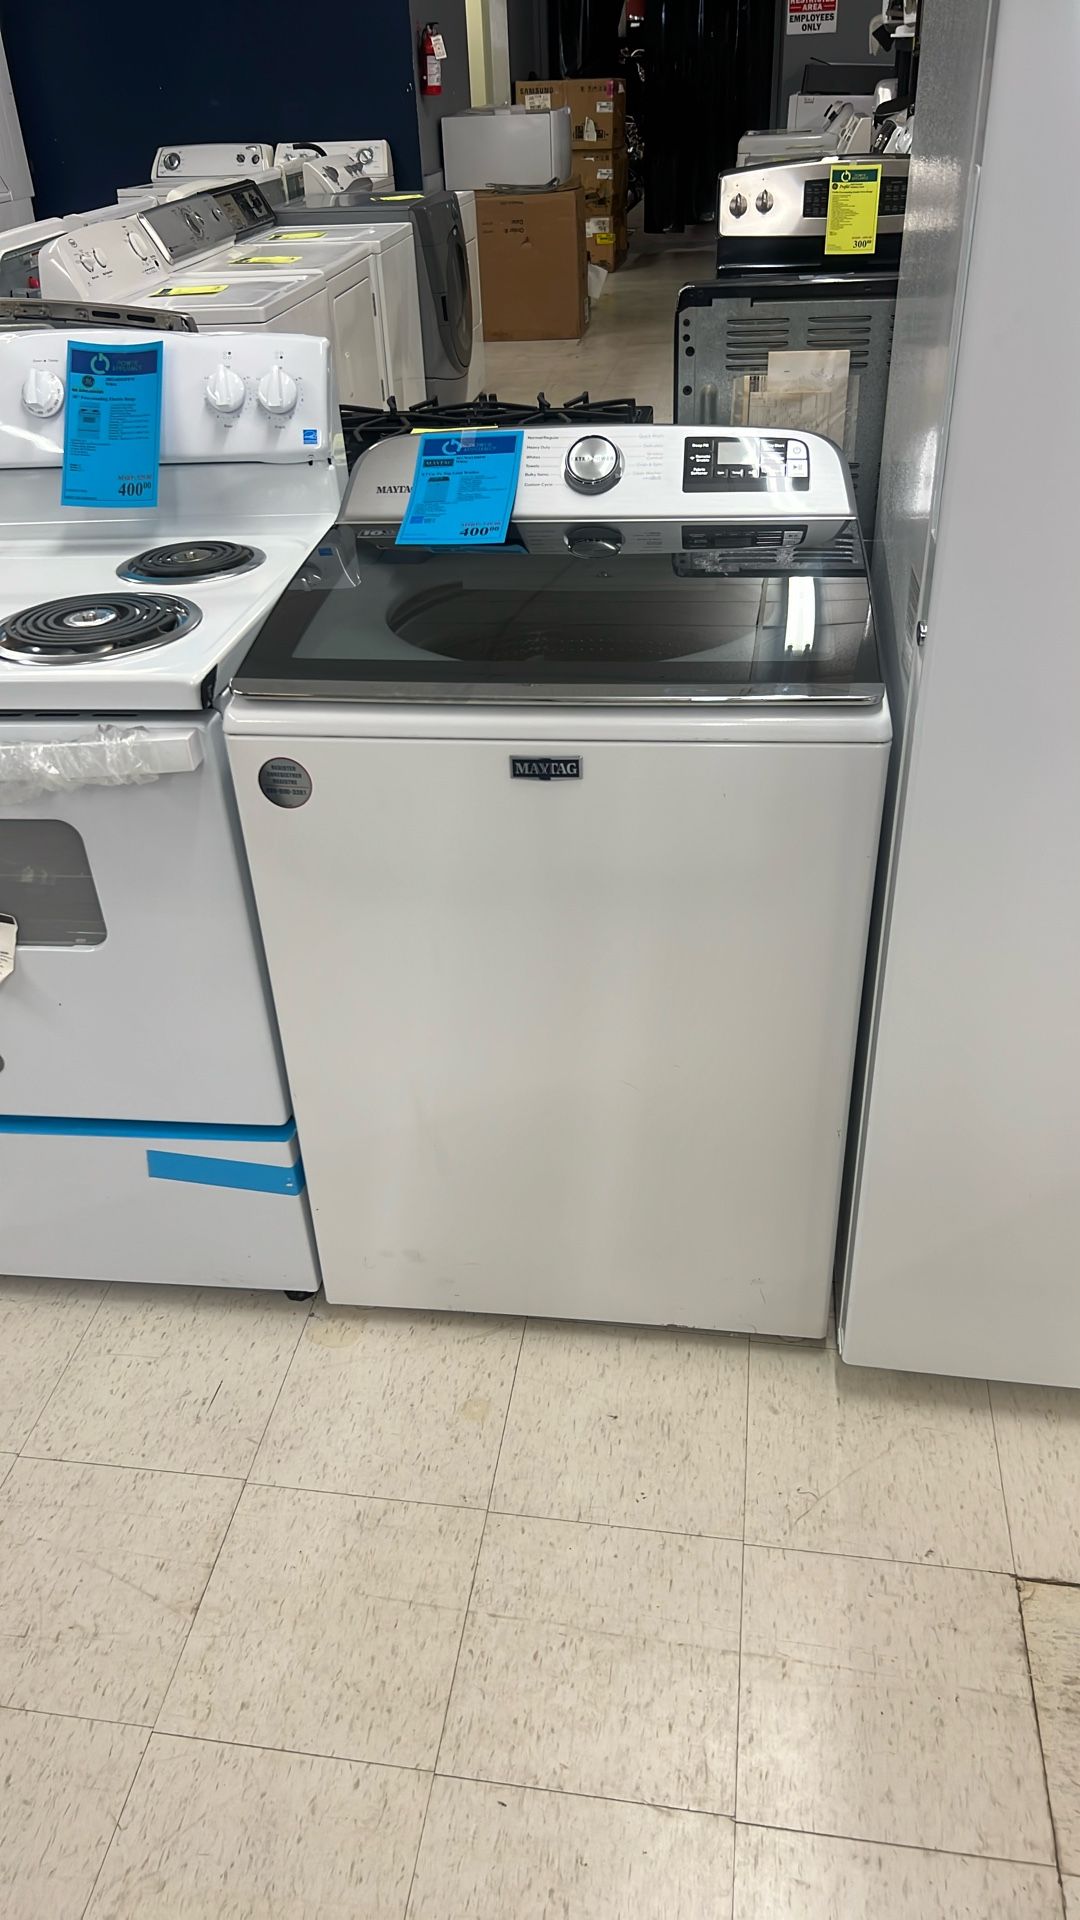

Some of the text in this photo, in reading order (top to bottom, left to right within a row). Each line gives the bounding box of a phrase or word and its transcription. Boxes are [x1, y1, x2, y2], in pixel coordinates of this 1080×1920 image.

[789, 13, 835, 23] EMPLOYEES
[801, 23, 822, 31] ONLY
[519, 87, 554, 95] SAMSUNG
[376, 486, 413, 494] MAYTA
[515, 762, 577, 774] MAYTAG
